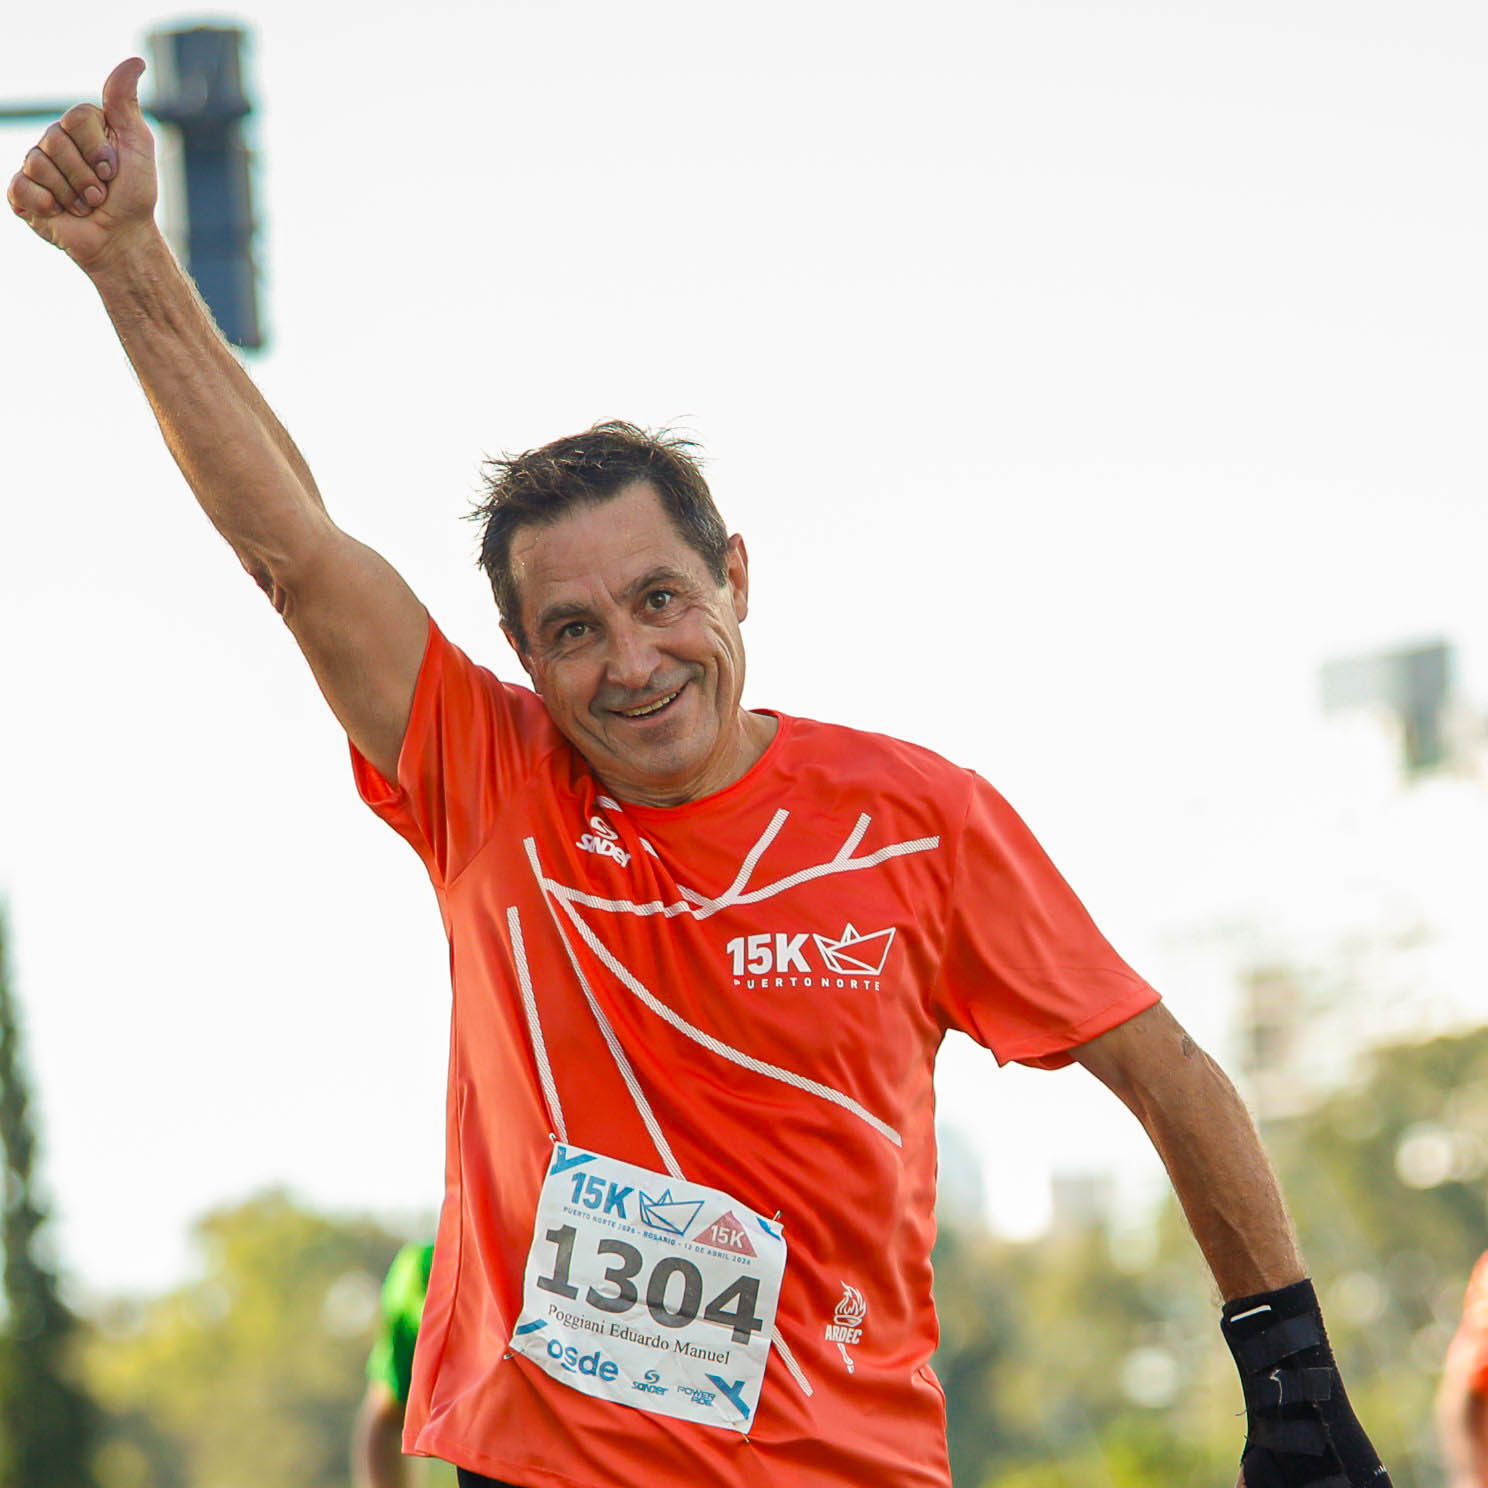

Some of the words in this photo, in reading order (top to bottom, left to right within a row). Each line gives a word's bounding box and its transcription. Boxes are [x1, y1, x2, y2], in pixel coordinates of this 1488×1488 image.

[726, 932, 812, 976] 15K
[733, 977, 812, 989] PUERTO
[821, 977, 880, 992] NORTE
[570, 1171, 635, 1220] 15K
[563, 1206, 591, 1220] PUERTO
[592, 1214, 617, 1228] NORTE
[643, 1230, 676, 1246] ROSARIO
[695, 1245, 705, 1254] DE
[707, 1249, 730, 1261] ABRIL
[711, 1224, 746, 1249] 15K
[536, 1223, 763, 1345] 1304
[547, 1303, 606, 1334] Poggiani
[610, 1325, 670, 1350] Eduardo
[675, 1338, 731, 1365] Manuel
[824, 1324, 863, 1344] ARDEC
[546, 1338, 619, 1382] osde
